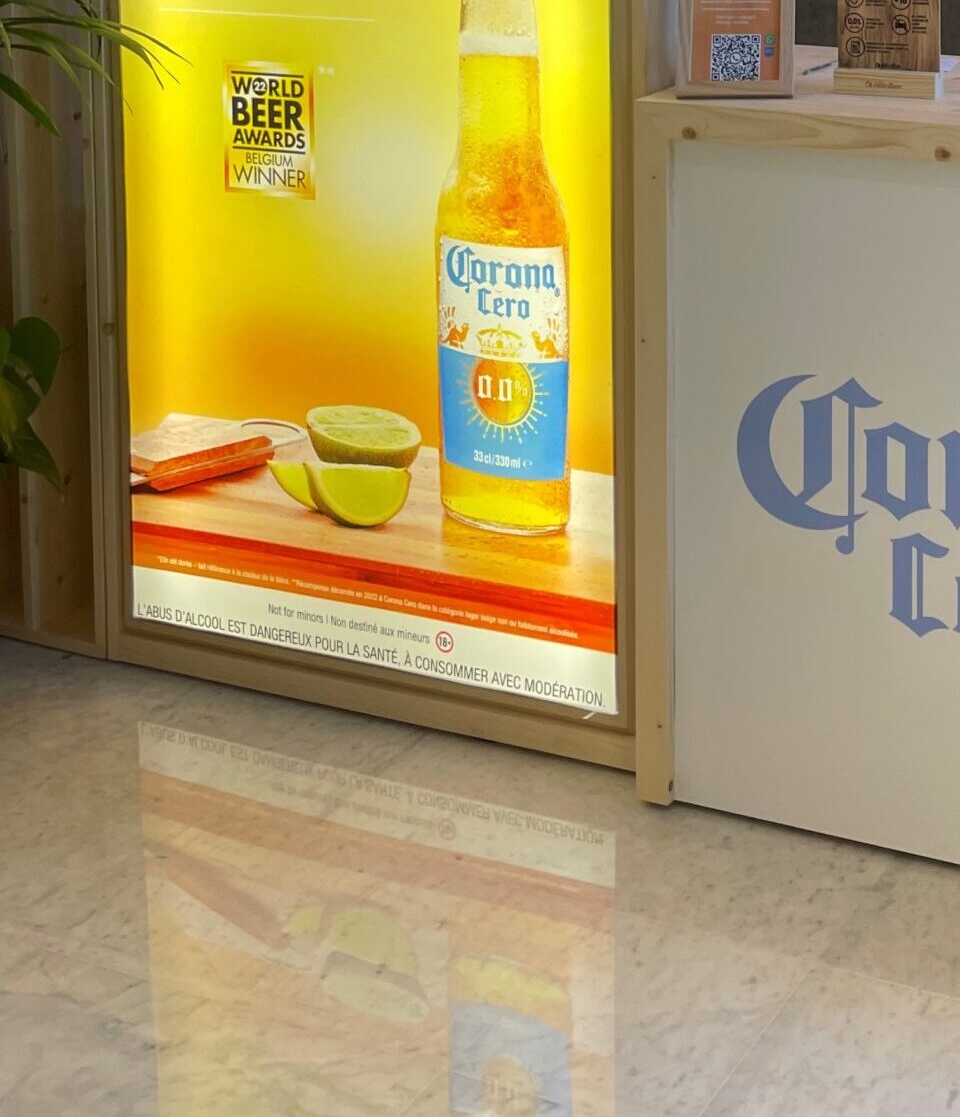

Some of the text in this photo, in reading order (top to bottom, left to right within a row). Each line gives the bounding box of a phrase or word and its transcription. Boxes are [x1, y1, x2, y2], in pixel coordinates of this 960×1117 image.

[231, 96, 305, 131] BEER
[233, 128, 306, 149] AWARDS
[233, 163, 306, 188] WINNER
[245, 152, 293, 168] BELGIUM
[446, 244, 558, 293] Corona
[476, 287, 530, 319] Cero
[477, 373, 527, 402] 0.0%
[268, 603, 282, 616] Not
[283, 604, 295, 619] for
[296, 610, 324, 624] minors
[330, 615, 347, 628] Non
[380, 625, 395, 637] aux
[397, 628, 430, 644] mineurs
[137, 602, 172, 621] L'ABUS
[175, 609, 225, 631] D'ALCOOL
[227, 619, 247, 634] EST
[249, 622, 312, 647] DANGEREUX
[314, 635, 344, 653] POUR
[346, 642, 361, 656] LA
[403, 653, 412, 668] À
[415, 654, 488, 683] CONSOMMER
[491, 671, 521, 690] AVEC
[524, 677, 606, 708] MODÉRATION.
